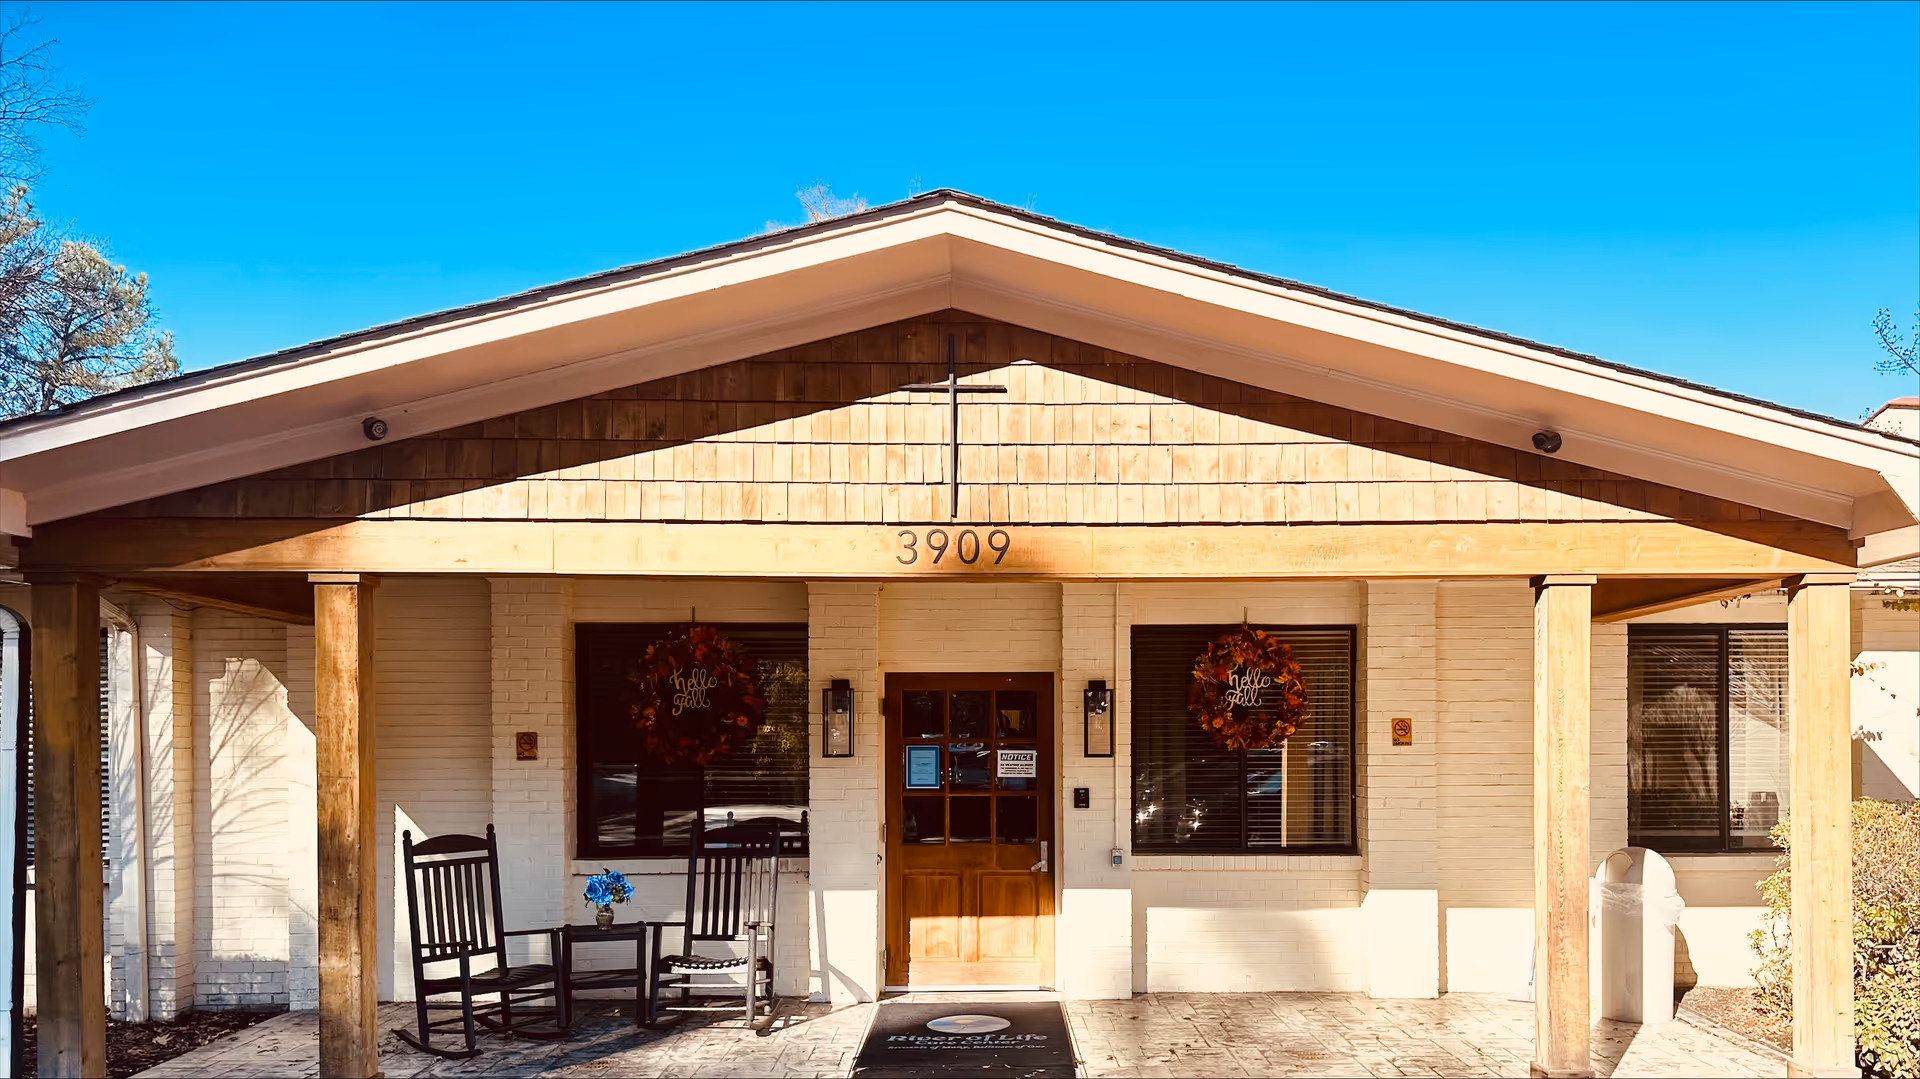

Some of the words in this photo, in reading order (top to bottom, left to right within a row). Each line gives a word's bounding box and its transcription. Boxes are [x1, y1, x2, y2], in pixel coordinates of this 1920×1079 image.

[896, 528, 1011, 565] 3909
[669, 667, 718, 695] hello
[1226, 663, 1271, 691] hello
[886, 1034, 961, 1042] River
[966, 1033, 996, 1042] of
[998, 1033, 1048, 1041] Life
